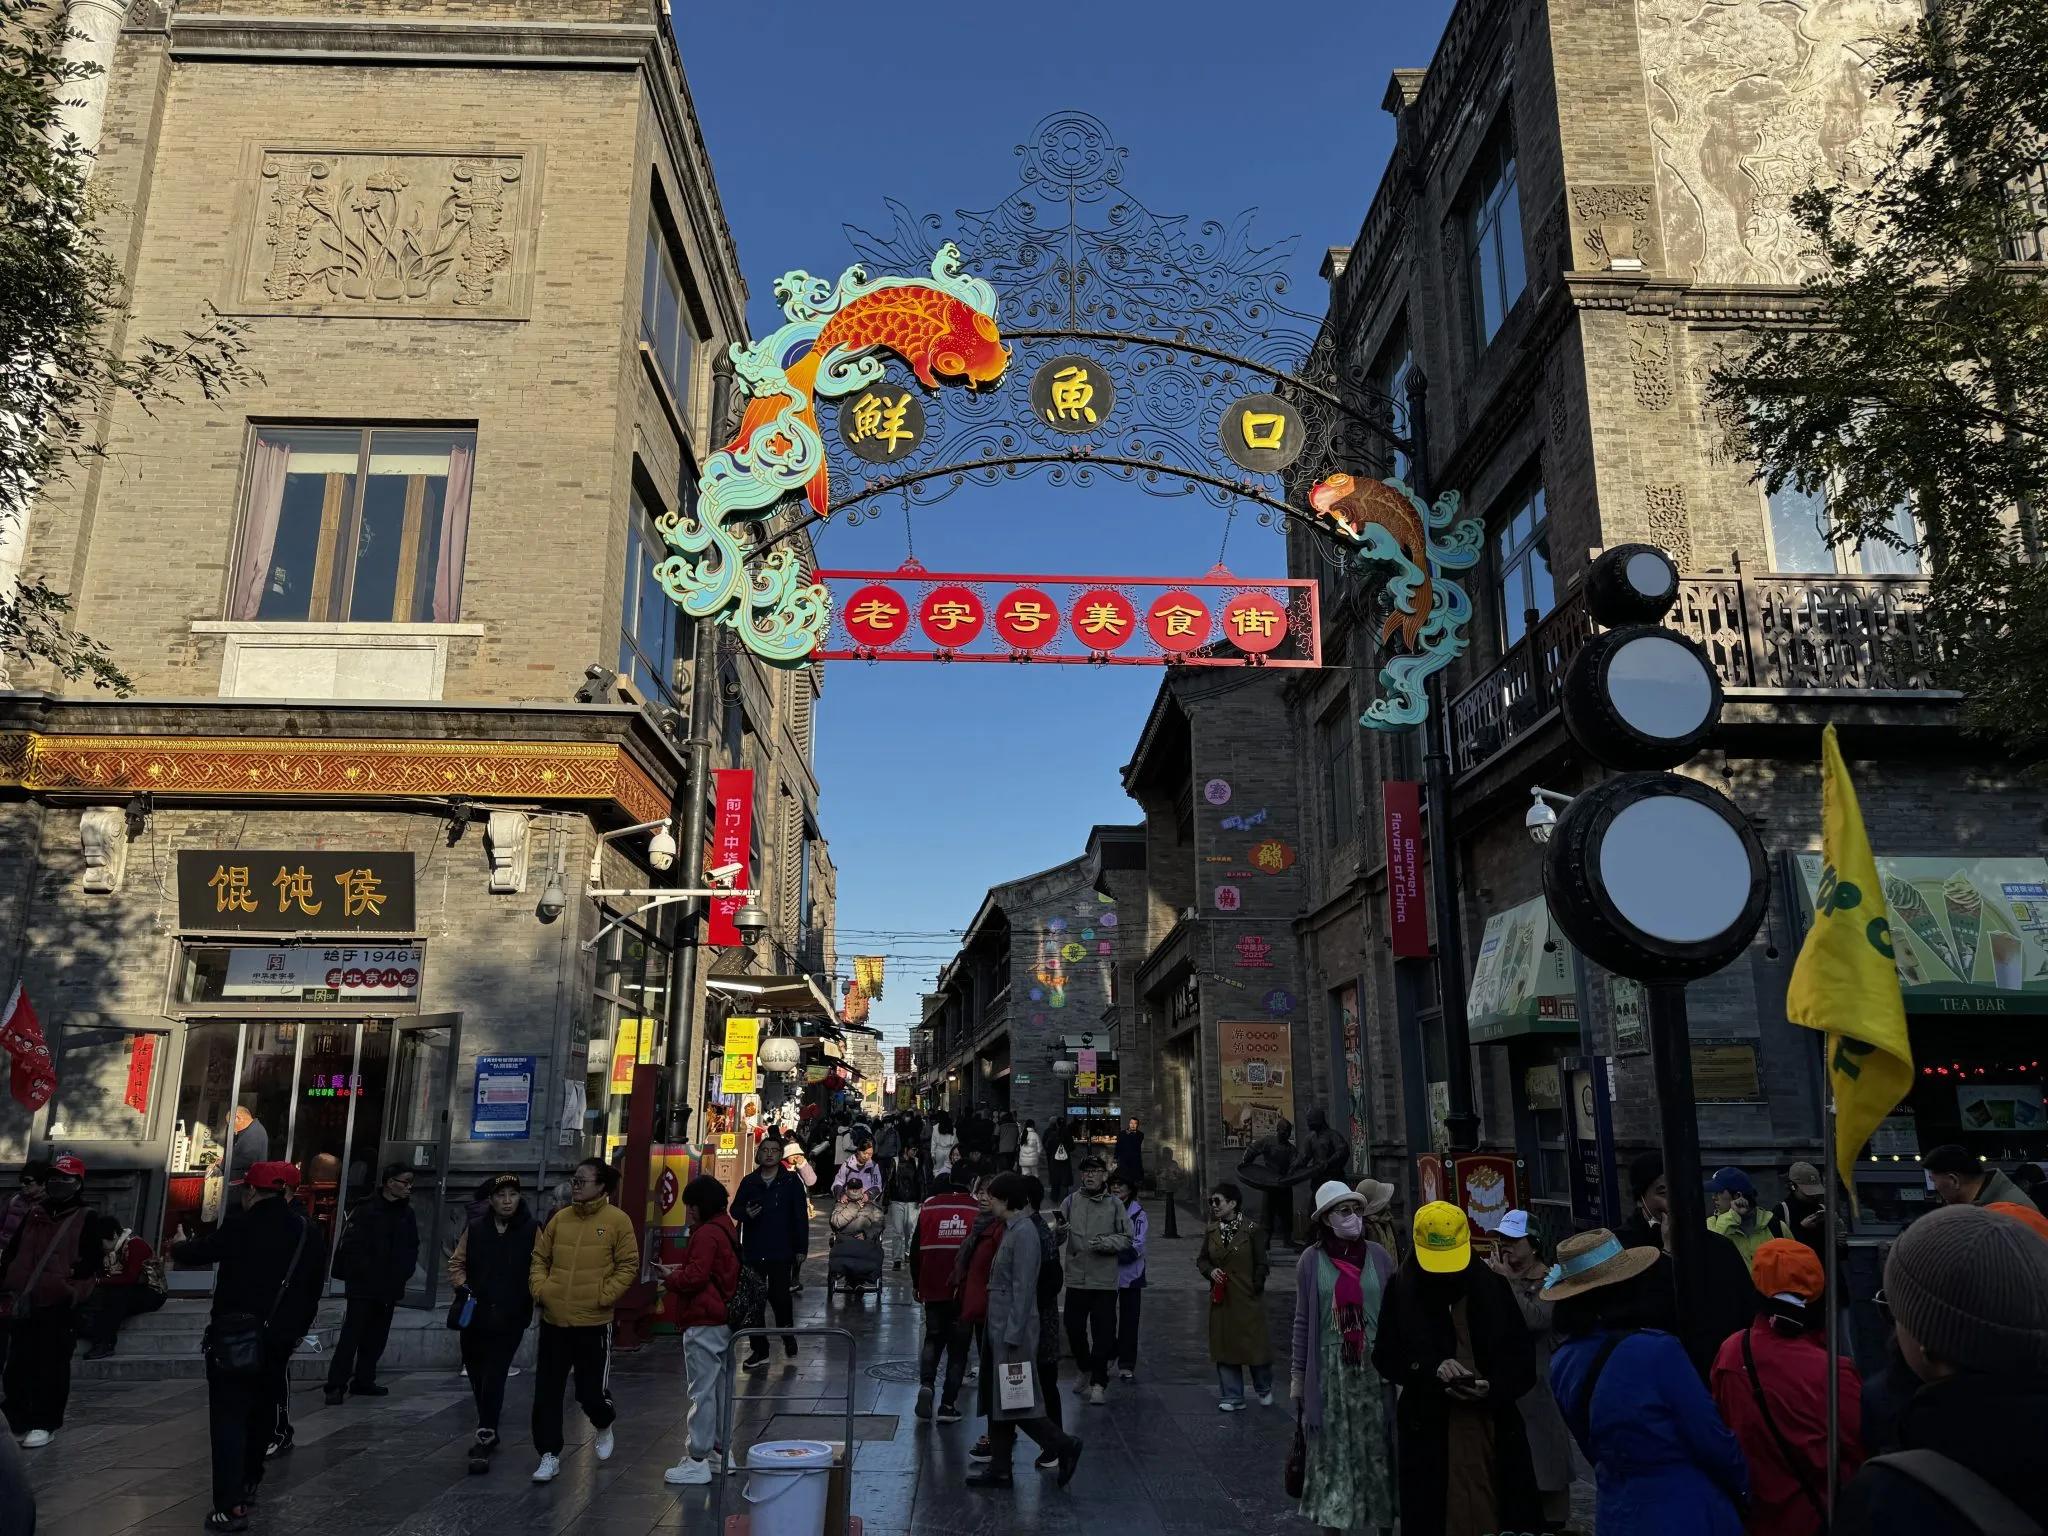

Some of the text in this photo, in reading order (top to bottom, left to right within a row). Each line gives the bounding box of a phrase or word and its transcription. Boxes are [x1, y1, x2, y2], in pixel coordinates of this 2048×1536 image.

[850, 366, 1285, 454] 鮮魚口
[851, 600, 1280, 639] 老字号美食街
[208, 864, 388, 917] 馄饨侯
[328, 969, 418, 988] 老北京小吃
[1939, 998, 2007, 1011] TEA BAR
